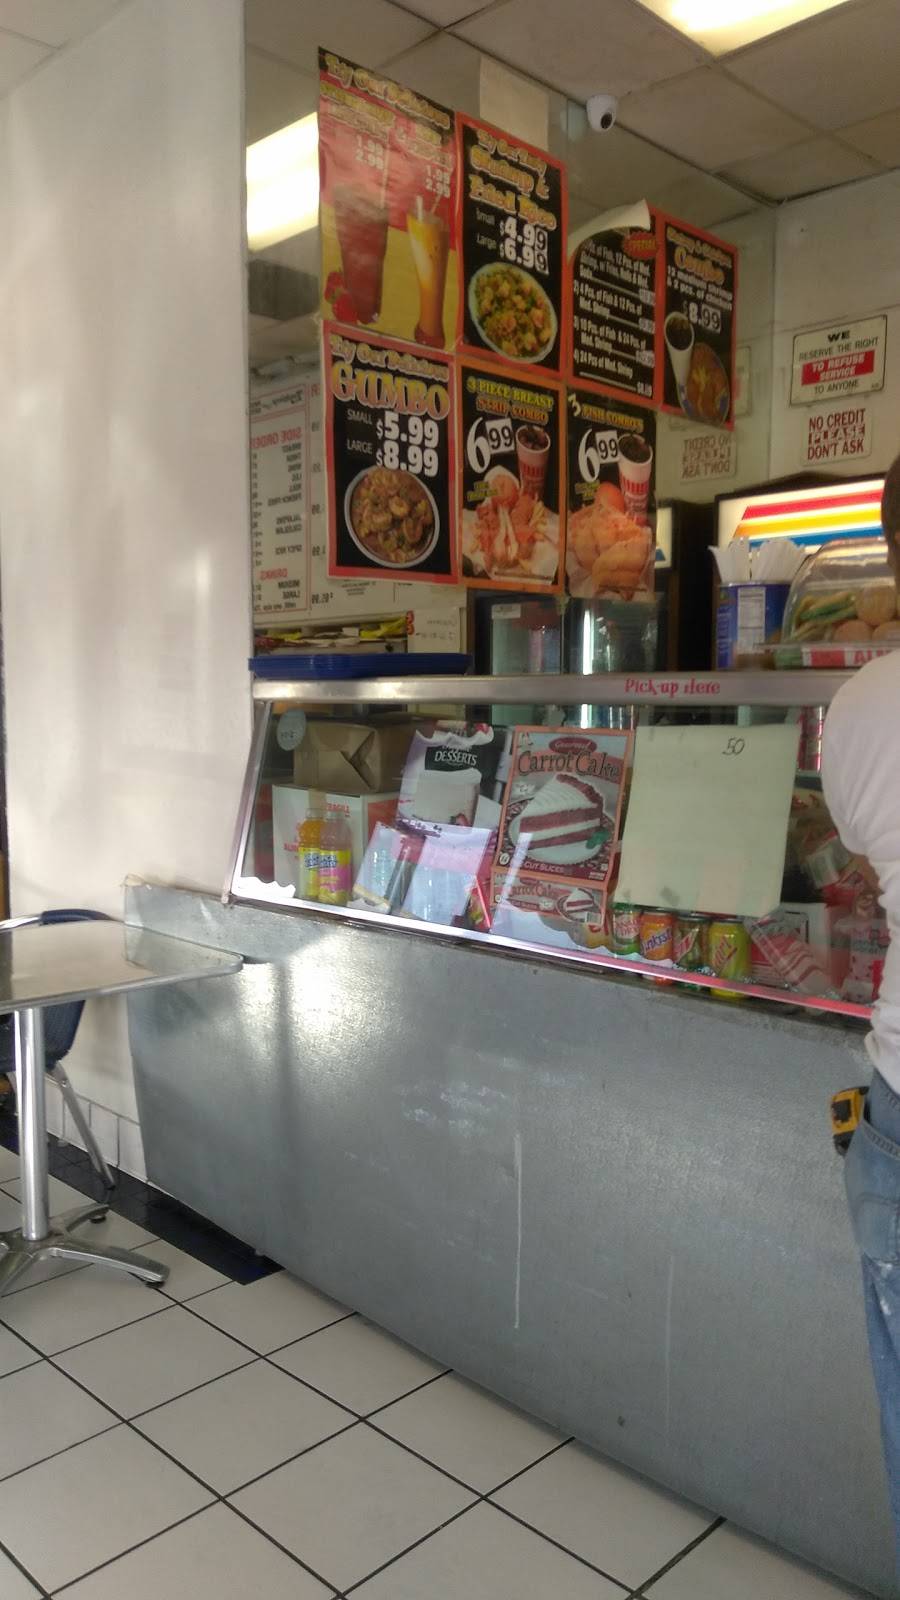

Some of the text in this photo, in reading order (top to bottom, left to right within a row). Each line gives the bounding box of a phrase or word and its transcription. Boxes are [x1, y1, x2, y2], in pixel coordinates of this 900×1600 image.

[827, 329, 850, 343] WE
[799, 336, 879, 362] RESERVE THE RIGHT
[812, 362, 825, 373] TO
[331, 360, 450, 421] GUMBO
[815, 383, 825, 395] TO
[826, 379, 860, 393] ANYONE
[511, 386, 554, 412] BREAST
[347, 409, 373, 426] SMALL
[808, 408, 866, 431] NO CREDIT
[376, 411, 439, 449] $5.99
[347, 438, 373, 456] LARGE
[376, 440, 439, 477] $8.99
[807, 438, 864, 461] DON'T ASK
[434, 750, 478, 767] DESSERTS
[518, 750, 619, 780] Carrot Cake
